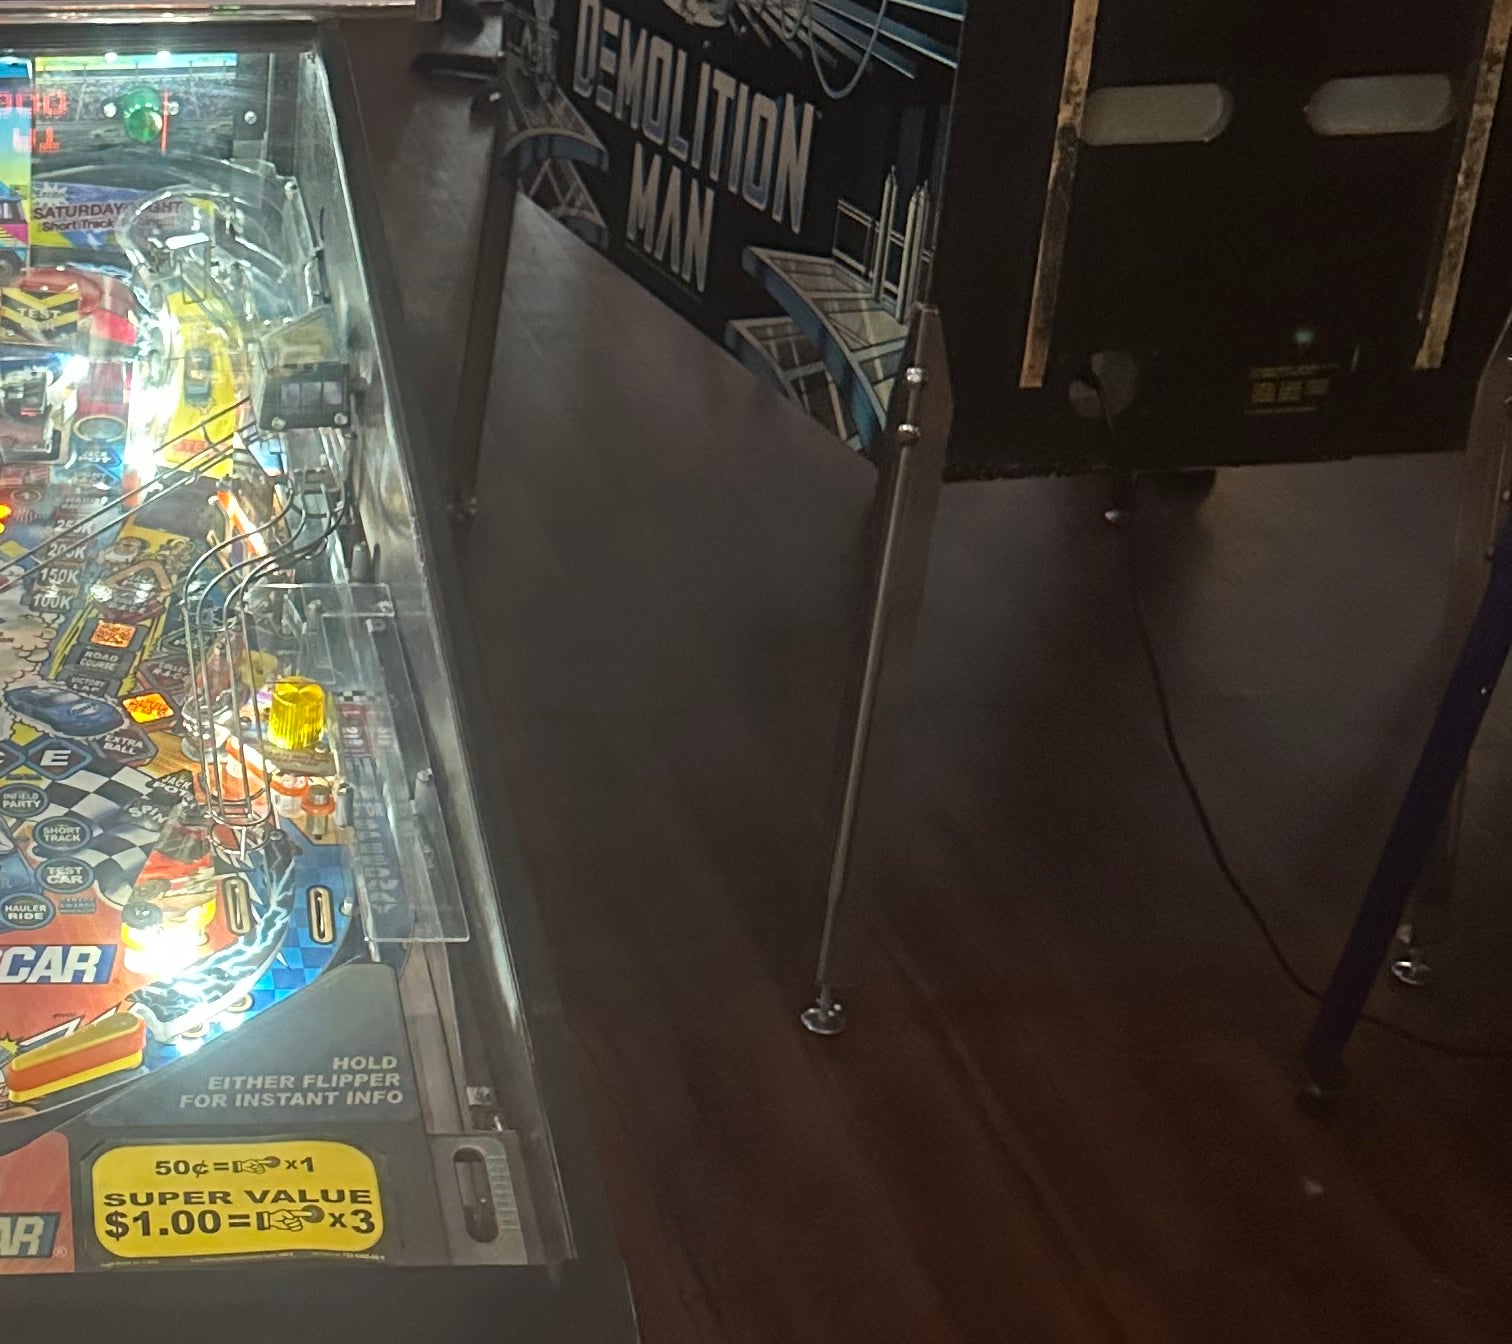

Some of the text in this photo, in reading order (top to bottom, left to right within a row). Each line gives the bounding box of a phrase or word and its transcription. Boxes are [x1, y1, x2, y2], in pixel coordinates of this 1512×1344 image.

[33, 203, 123, 220] SATURDAY
[626, 141, 715, 292] MAN
[42, 219, 78, 233] Short
[80, 217, 114, 230] Track
[17, 308, 61, 322] TEST
[40, 567, 79, 584] 150K
[105, 734, 144, 748] EXTRA
[103, 742, 136, 756] BALL
[40, 749, 71, 766] E
[162, 776, 192, 789] JACK
[3, 800, 41, 808] PARTY
[129, 805, 168, 824] SPIN
[43, 827, 81, 835] SHORT
[44, 834, 81, 842] TRACK
[47, 867, 83, 875] TEST
[46, 875, 83, 884] CAR
[5, 905, 47, 913] HAULER
[7, 912, 44, 920] RIDE
[332, 1056, 398, 1071] HOLD
[208, 1073, 401, 1091] EITHER FLIPPER
[180, 1090, 404, 1108] FOR INSTANT INFO
[286, 1157, 315, 1173] x1
[103, 1189, 373, 1207] SUPER VALUE
[328, 1208, 376, 1234] x3
